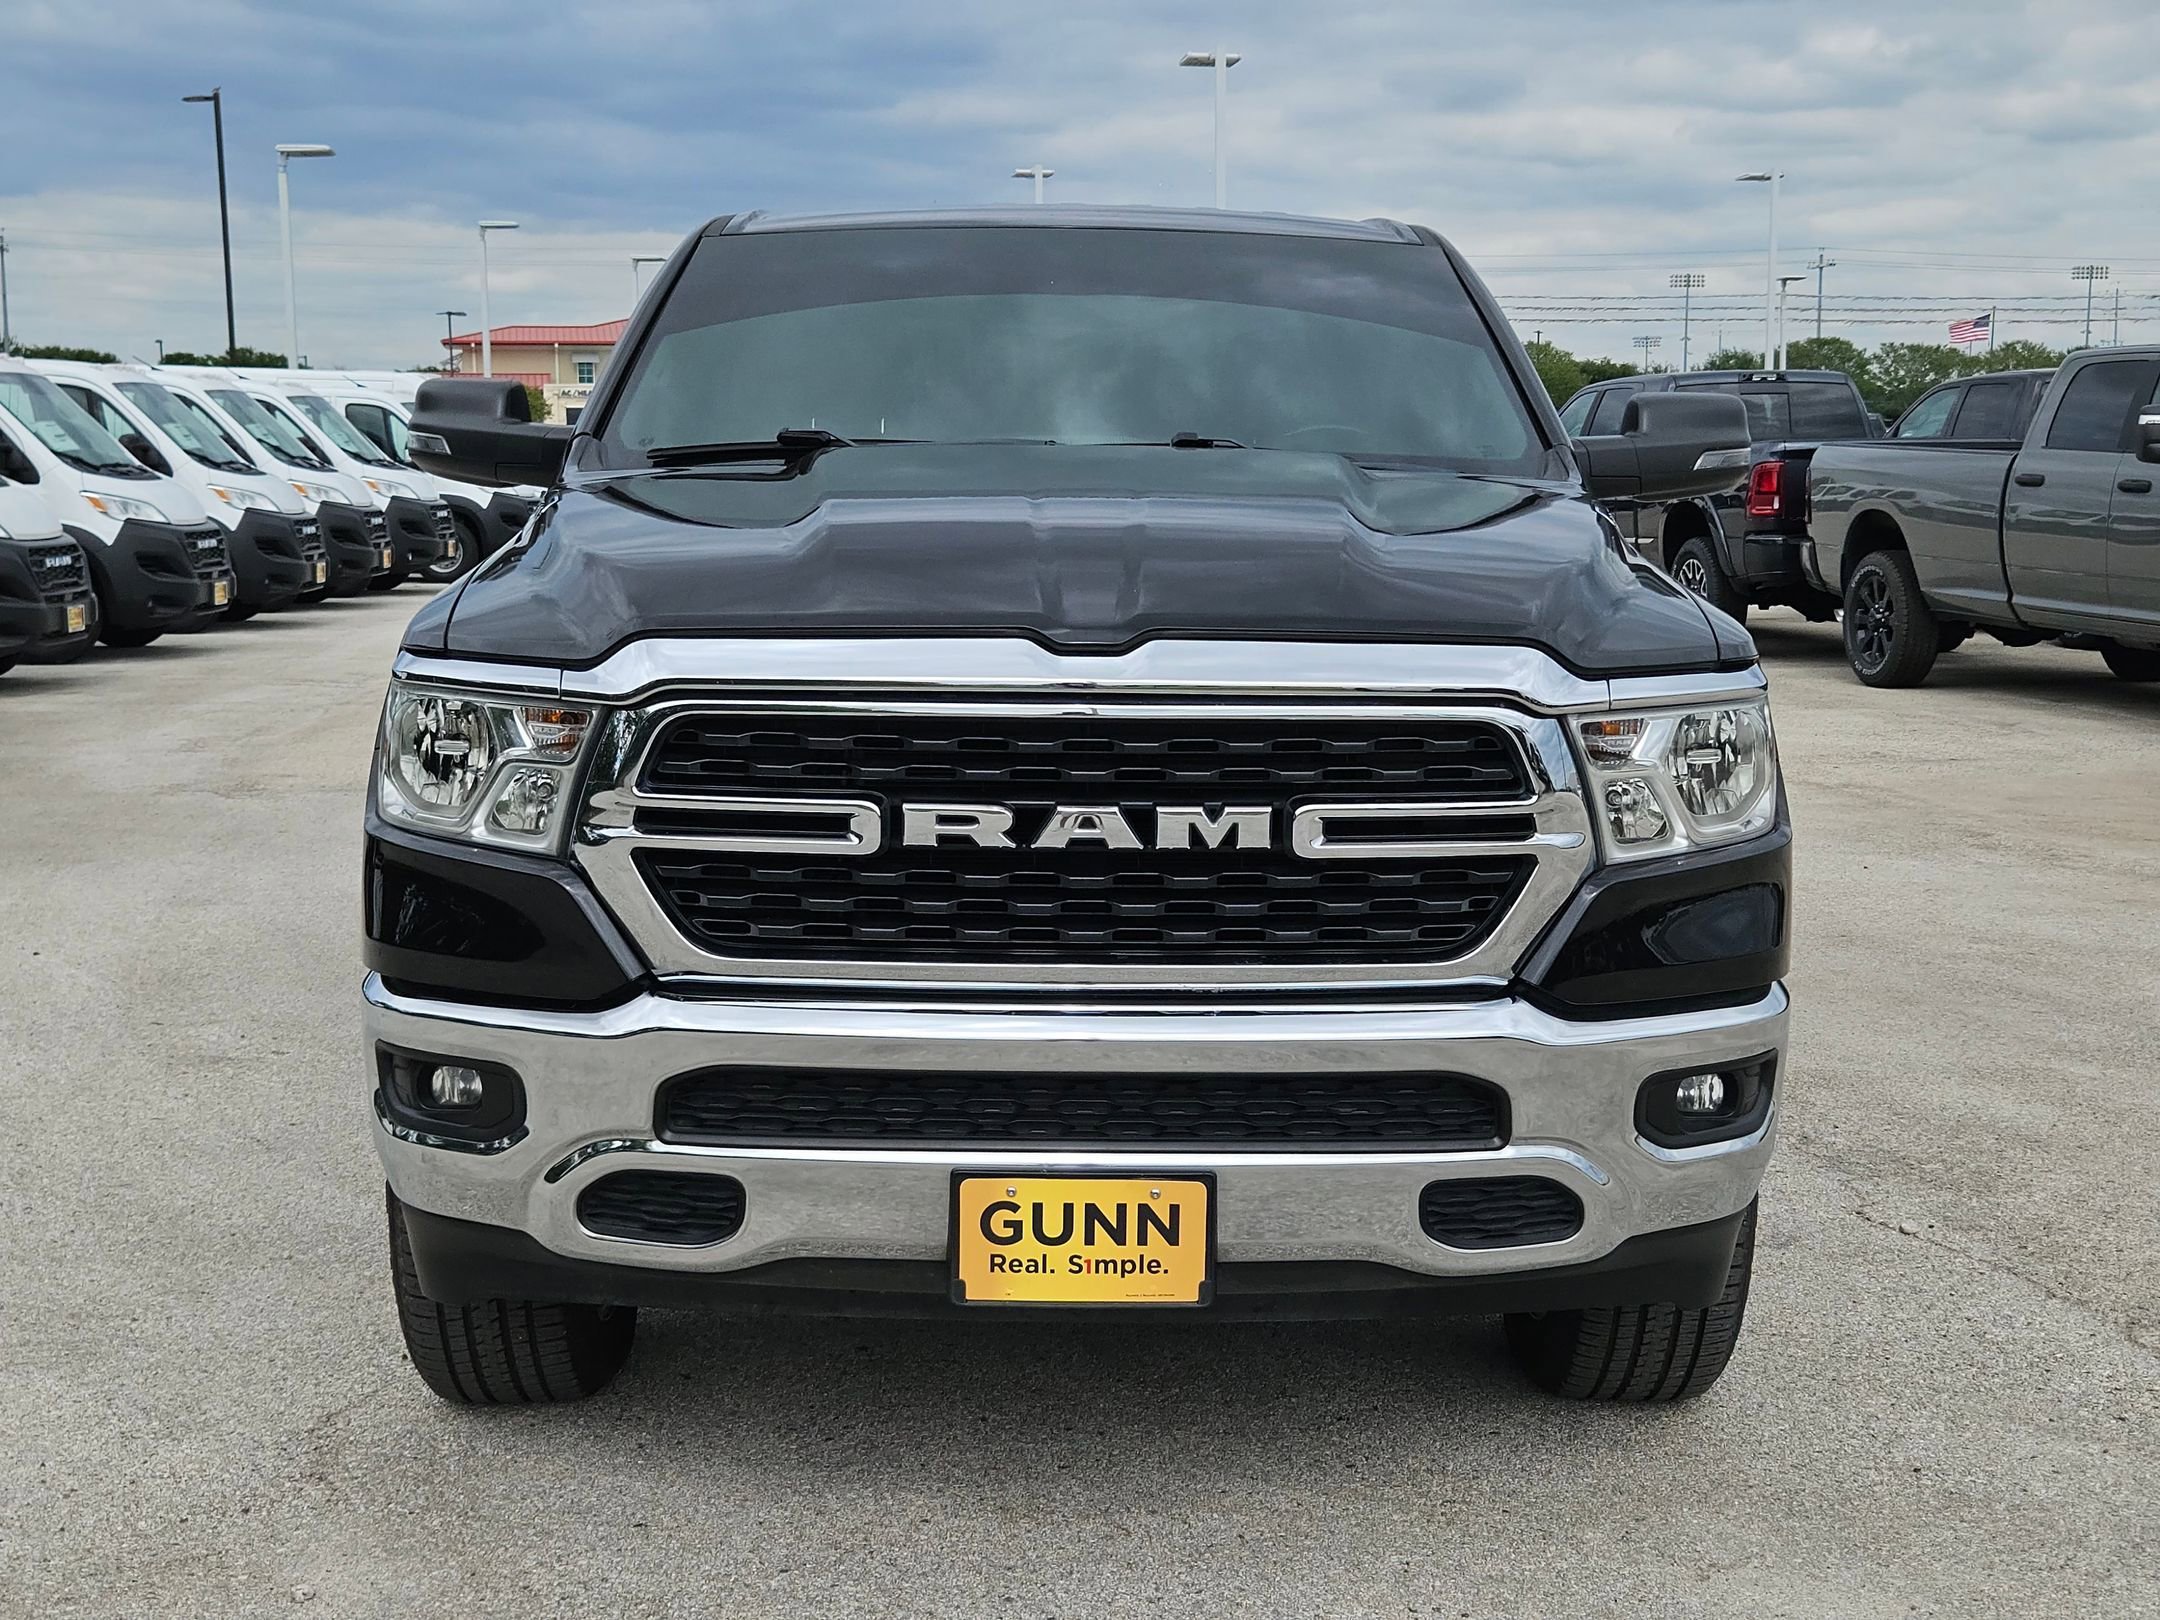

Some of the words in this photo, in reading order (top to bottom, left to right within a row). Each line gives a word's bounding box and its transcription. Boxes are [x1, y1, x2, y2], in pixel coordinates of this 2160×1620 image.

[902, 803, 1272, 849] RAM
[979, 1200, 1181, 1247] GUNN
[989, 1253, 1056, 1274] Real.
